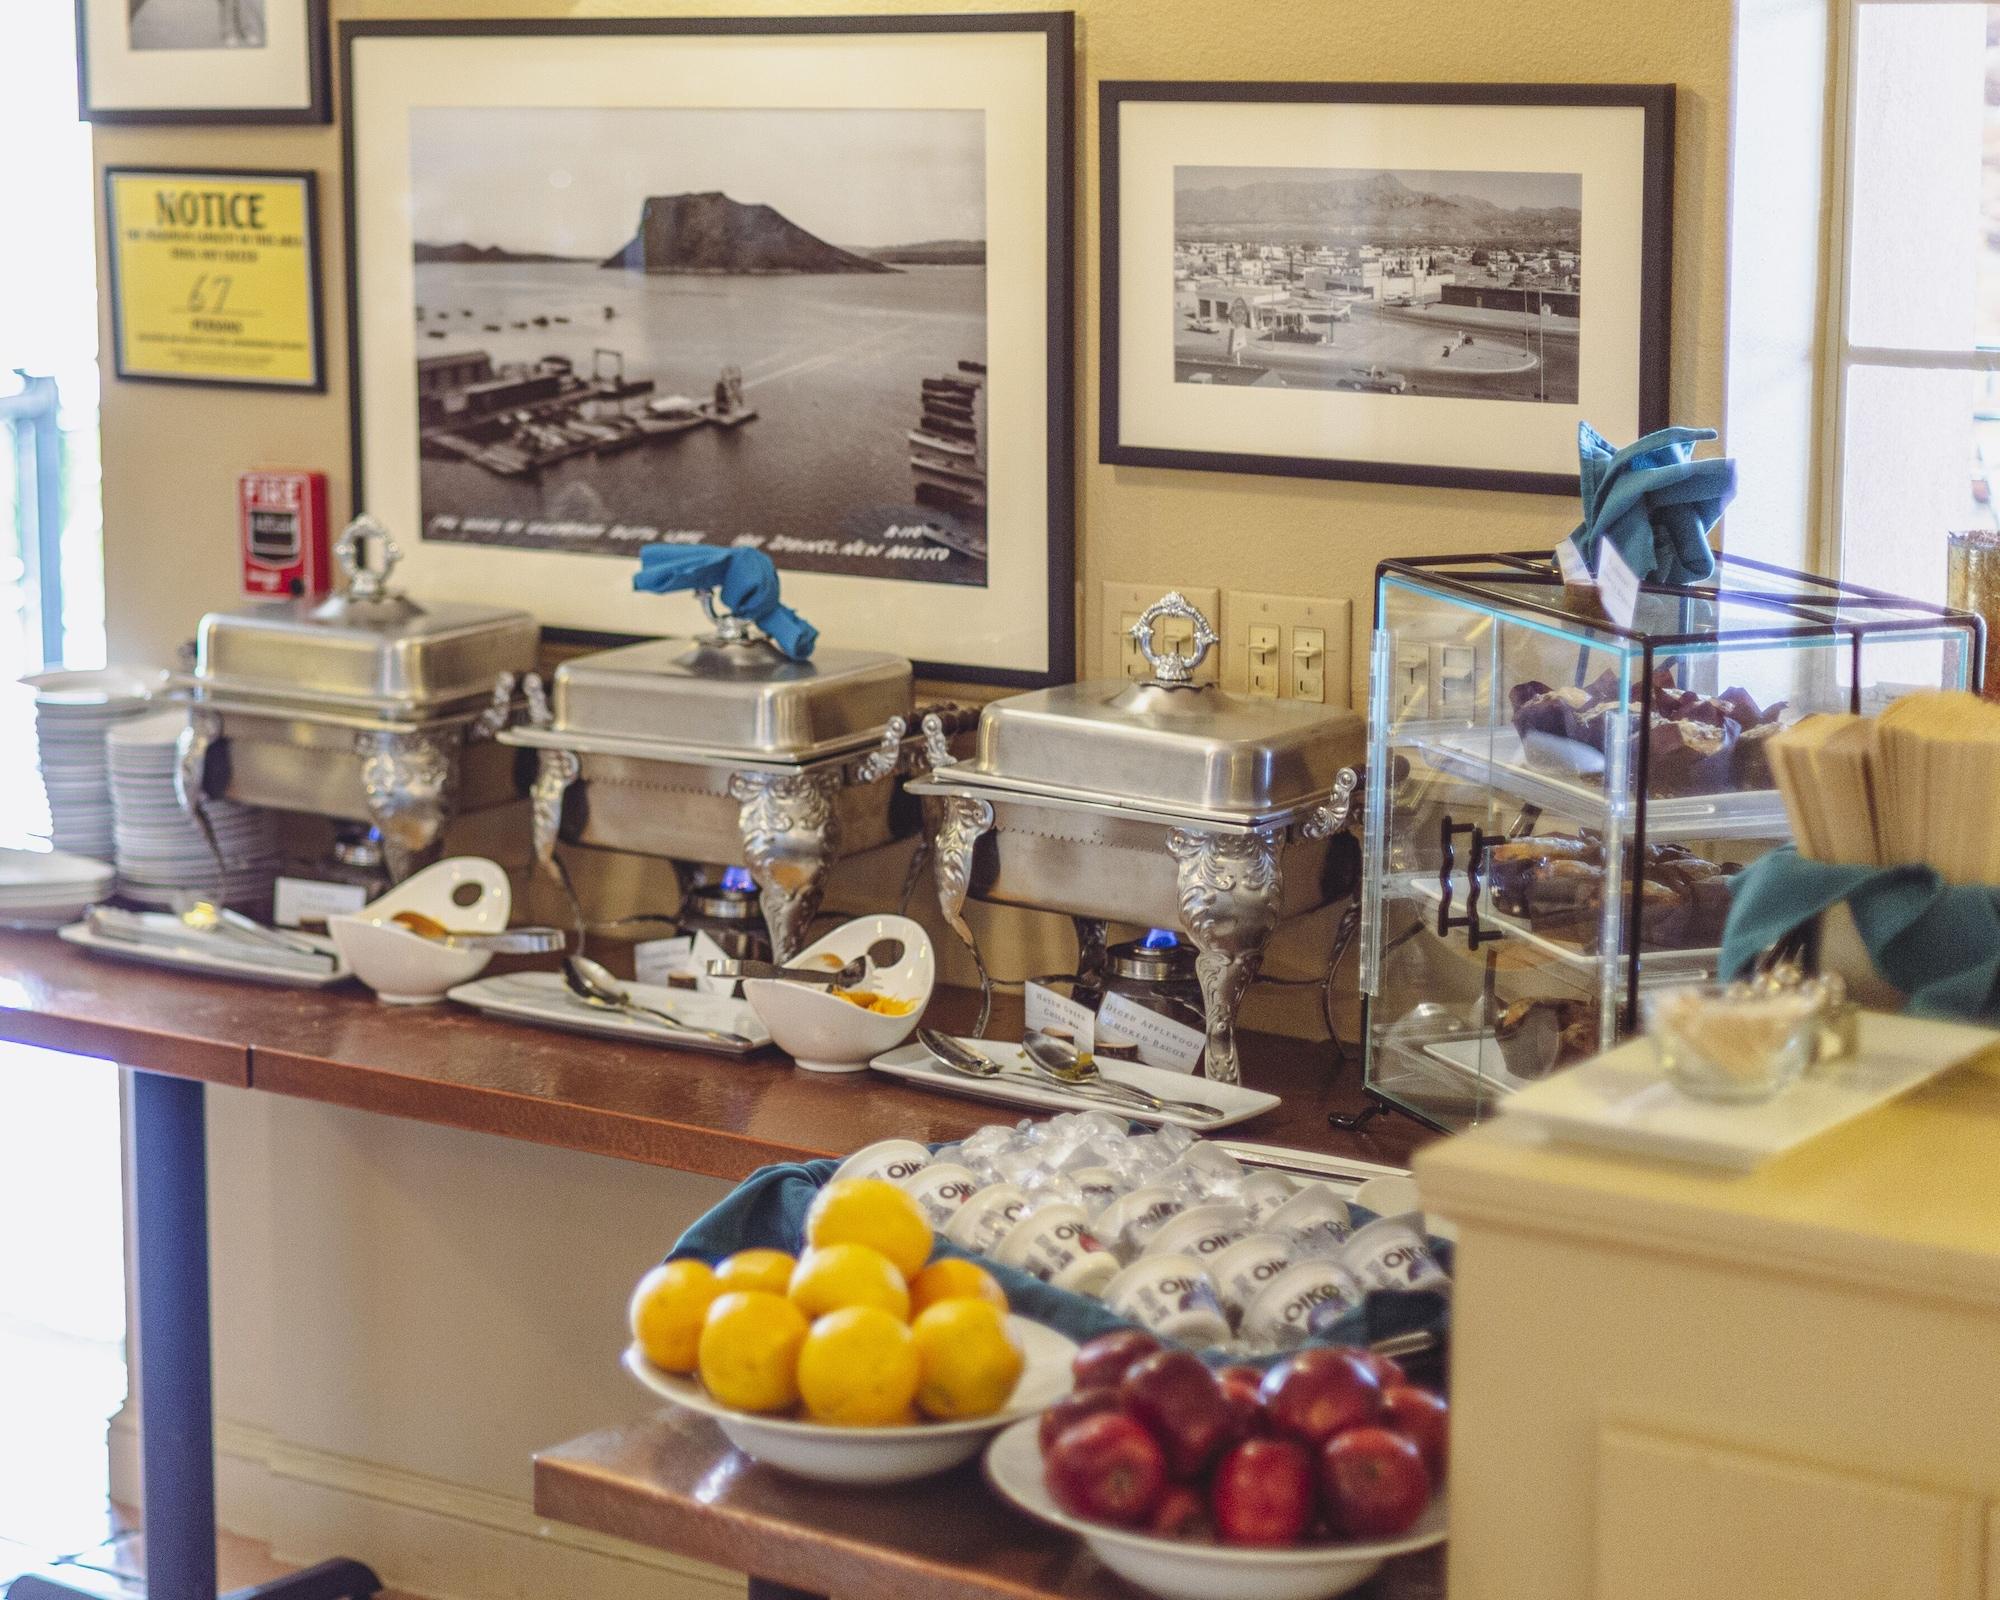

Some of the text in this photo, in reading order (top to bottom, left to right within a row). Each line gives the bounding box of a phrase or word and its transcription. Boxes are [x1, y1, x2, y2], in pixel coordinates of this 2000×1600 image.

[156, 192, 267, 229] NOTICE
[187, 272, 234, 314] 67
[245, 480, 299, 507] FIRE
[887, 1161, 926, 1179] OIK
[1284, 1284, 1340, 1322] OIKO
